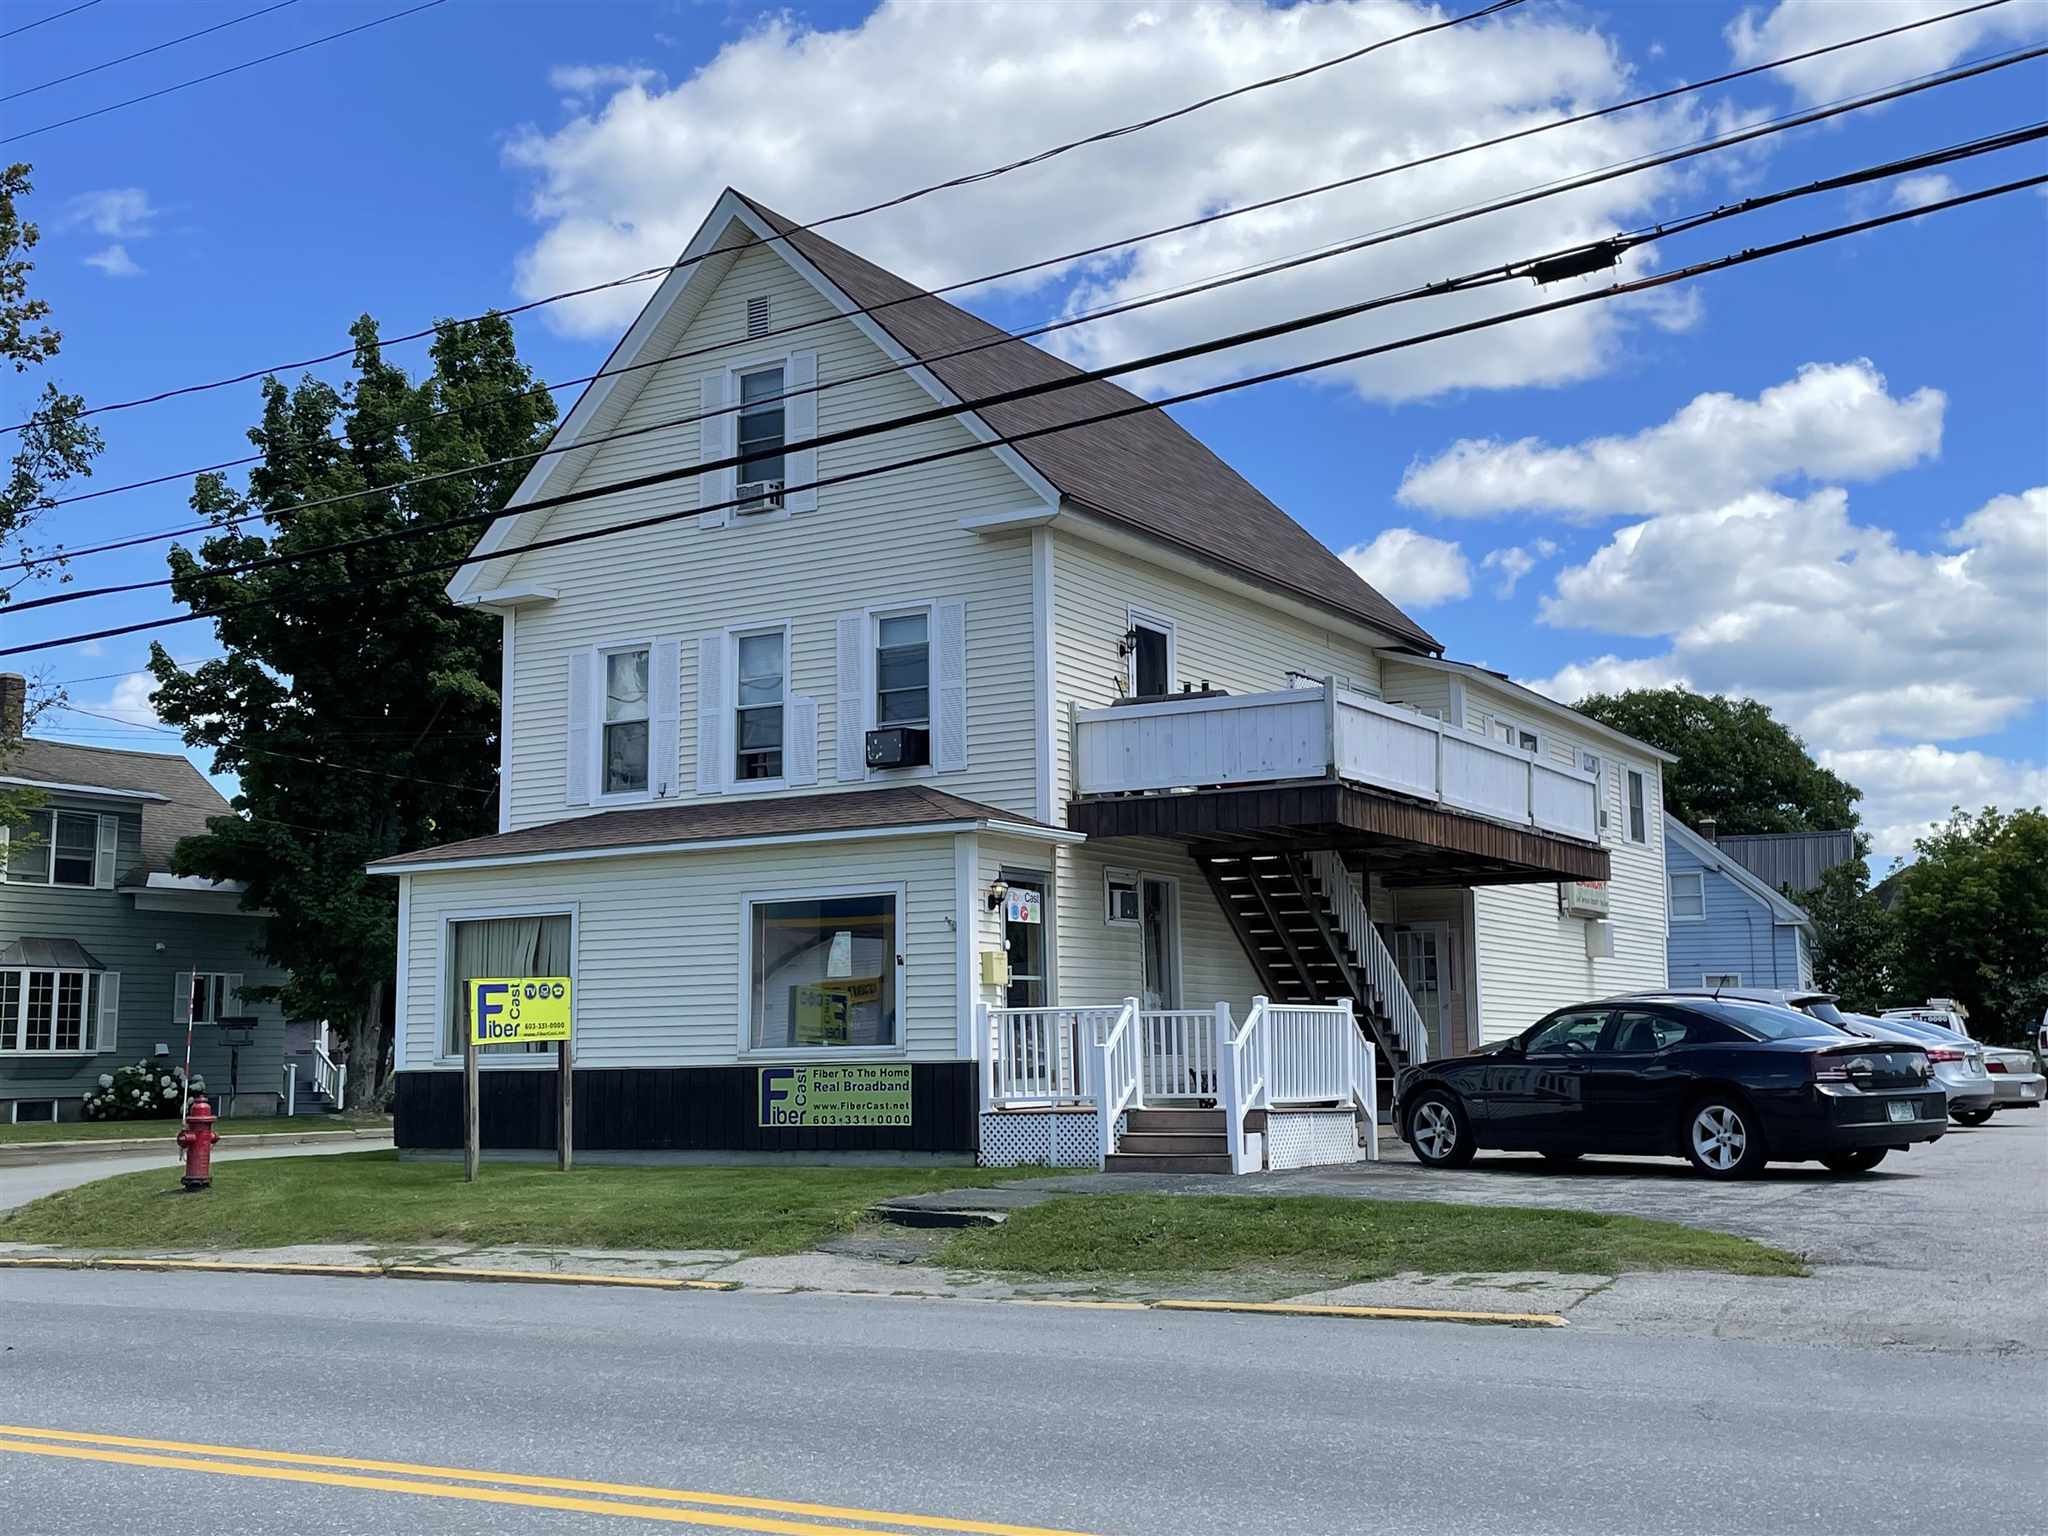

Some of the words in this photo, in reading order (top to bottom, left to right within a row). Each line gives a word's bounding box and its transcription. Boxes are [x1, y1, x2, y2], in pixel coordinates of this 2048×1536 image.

[1024, 892, 1040, 904] Cast
[509, 983, 520, 1019] Cast
[477, 984, 520, 1039] Fiber
[524, 1022, 565, 1030] 603-331-0000
[812, 1069, 839, 1078] Fiber
[841, 1068, 853, 1078] To
[856, 1068, 876, 1078] The
[879, 1068, 910, 1078] Home
[795, 1068, 807, 1106] Cast
[813, 1081, 840, 1092] Real
[843, 1080, 910, 1092] Broadband
[762, 1069, 807, 1125] Fiber
[813, 1101, 910, 1111] www.FiberCast.net
